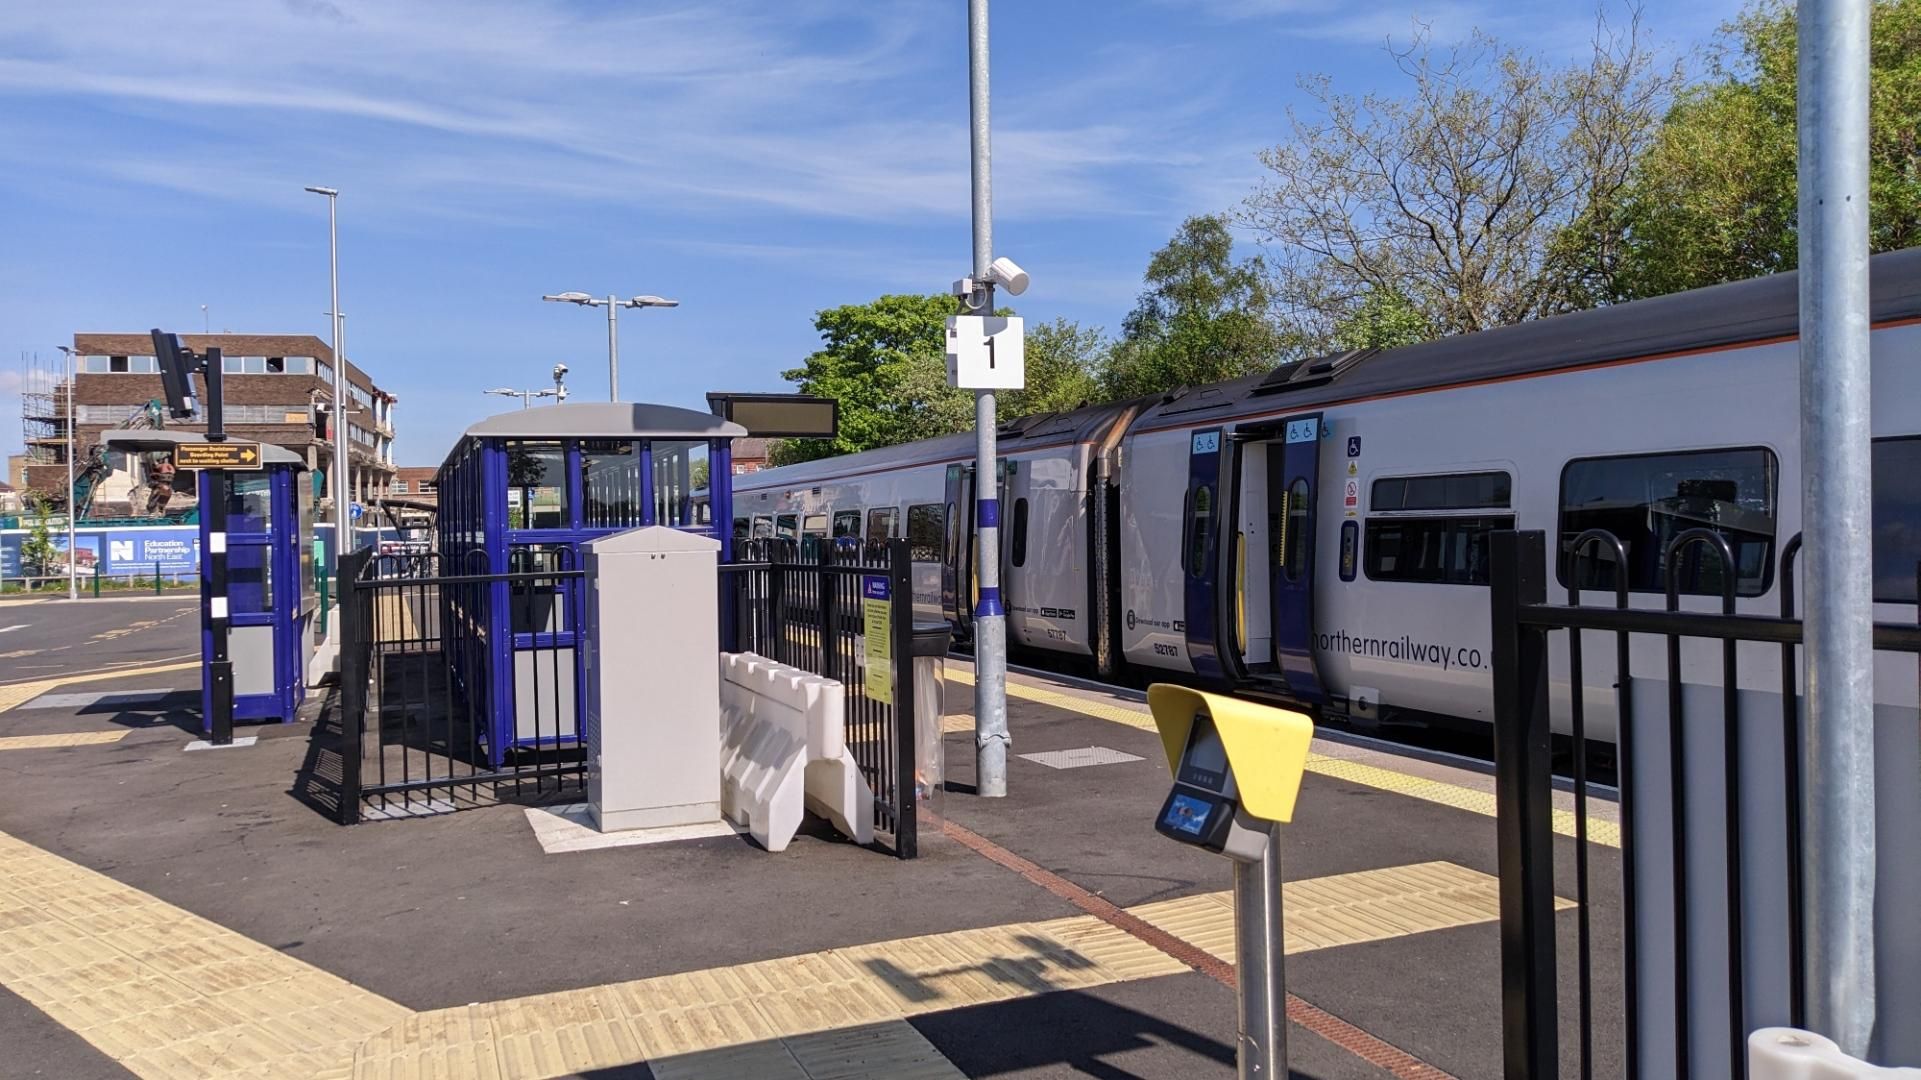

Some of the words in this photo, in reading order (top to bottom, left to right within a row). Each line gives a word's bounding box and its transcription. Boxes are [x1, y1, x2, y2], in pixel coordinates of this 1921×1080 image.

[983, 336, 995, 369] 1
[1153, 642, 1178, 657] 52787
[1312, 629, 1494, 671] northernrailway.co.
